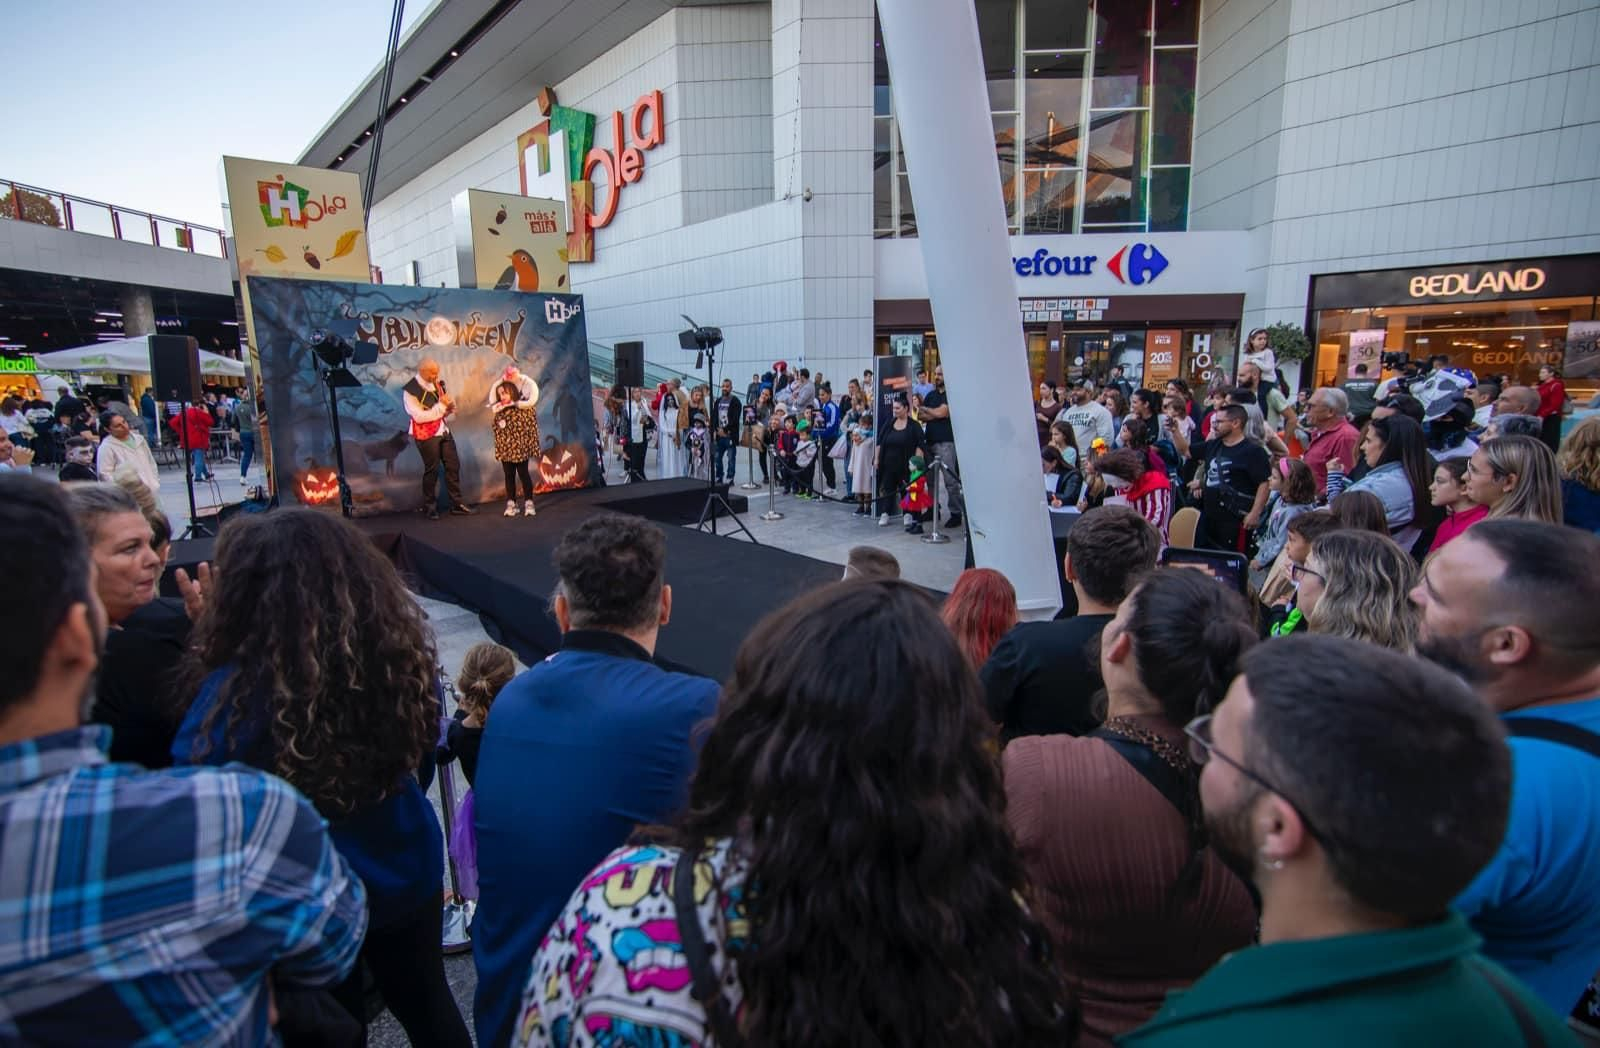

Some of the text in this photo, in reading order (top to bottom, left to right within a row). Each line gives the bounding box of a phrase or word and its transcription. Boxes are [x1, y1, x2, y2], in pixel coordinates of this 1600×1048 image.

[524, 209, 549, 221] más
[1012, 248, 1098, 277] efour
[1409, 267, 1546, 298] BEDLAND
[1472, 352, 1563, 364] BEDLAND
